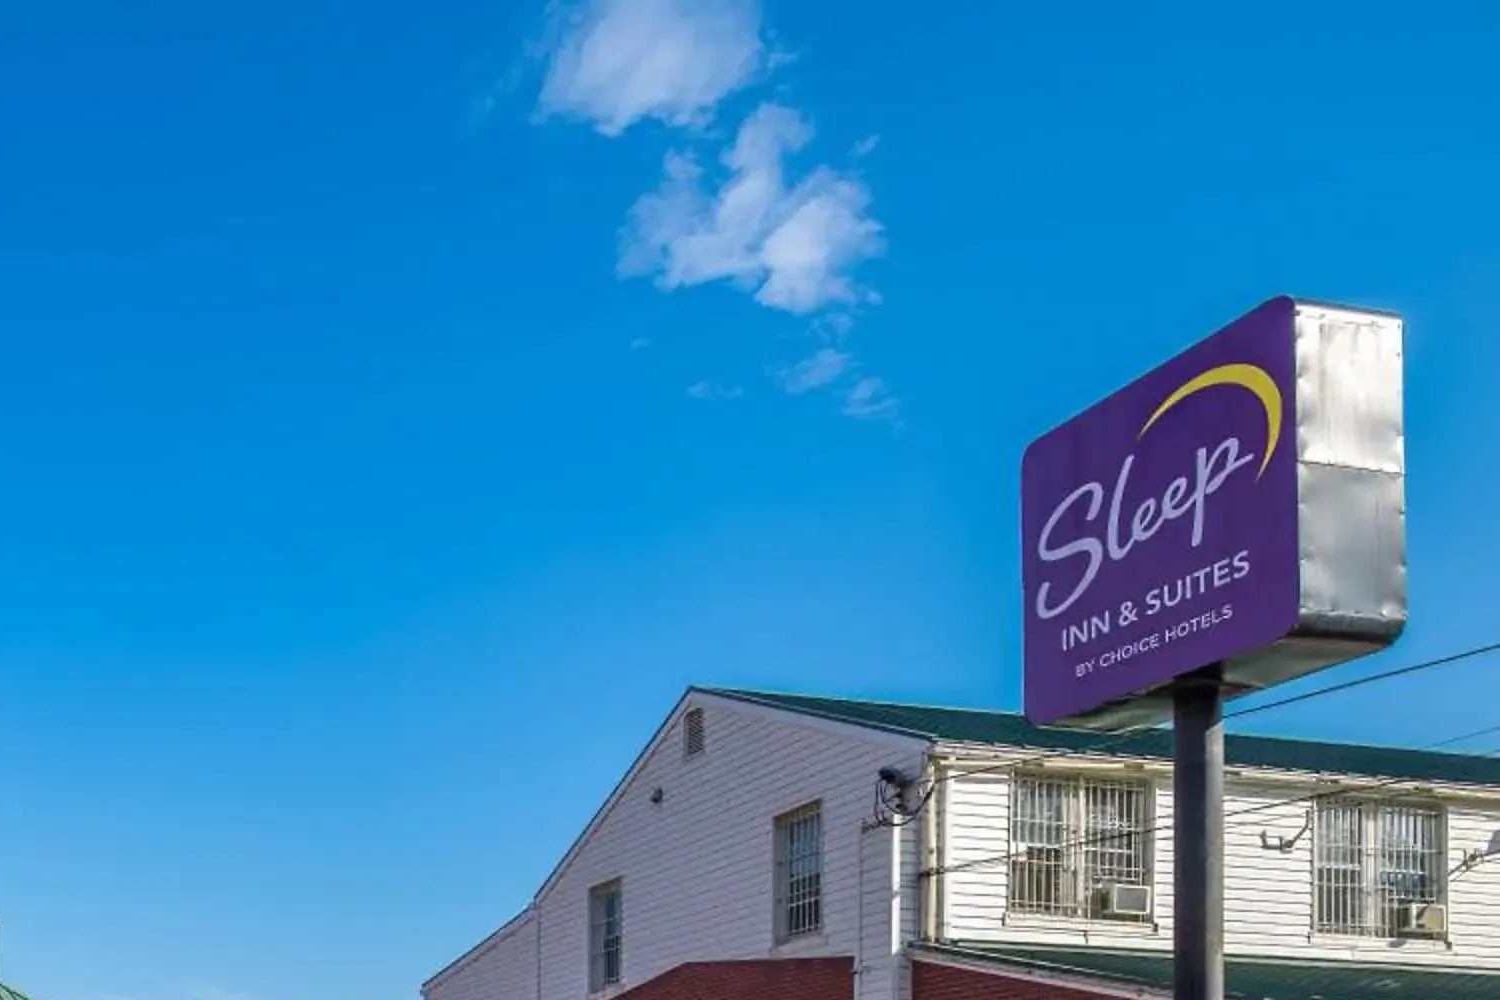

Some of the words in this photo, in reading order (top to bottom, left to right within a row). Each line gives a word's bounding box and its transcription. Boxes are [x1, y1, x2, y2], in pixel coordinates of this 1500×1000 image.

[1036, 436, 1254, 619] Sleep
[1061, 610, 1110, 651] INN
[1118, 601, 1139, 627] &
[1145, 549, 1251, 615] SUITES
[1075, 659, 1096, 678] BY
[1099, 632, 1161, 668] CHOICE
[1164, 604, 1234, 643] HOTELS
